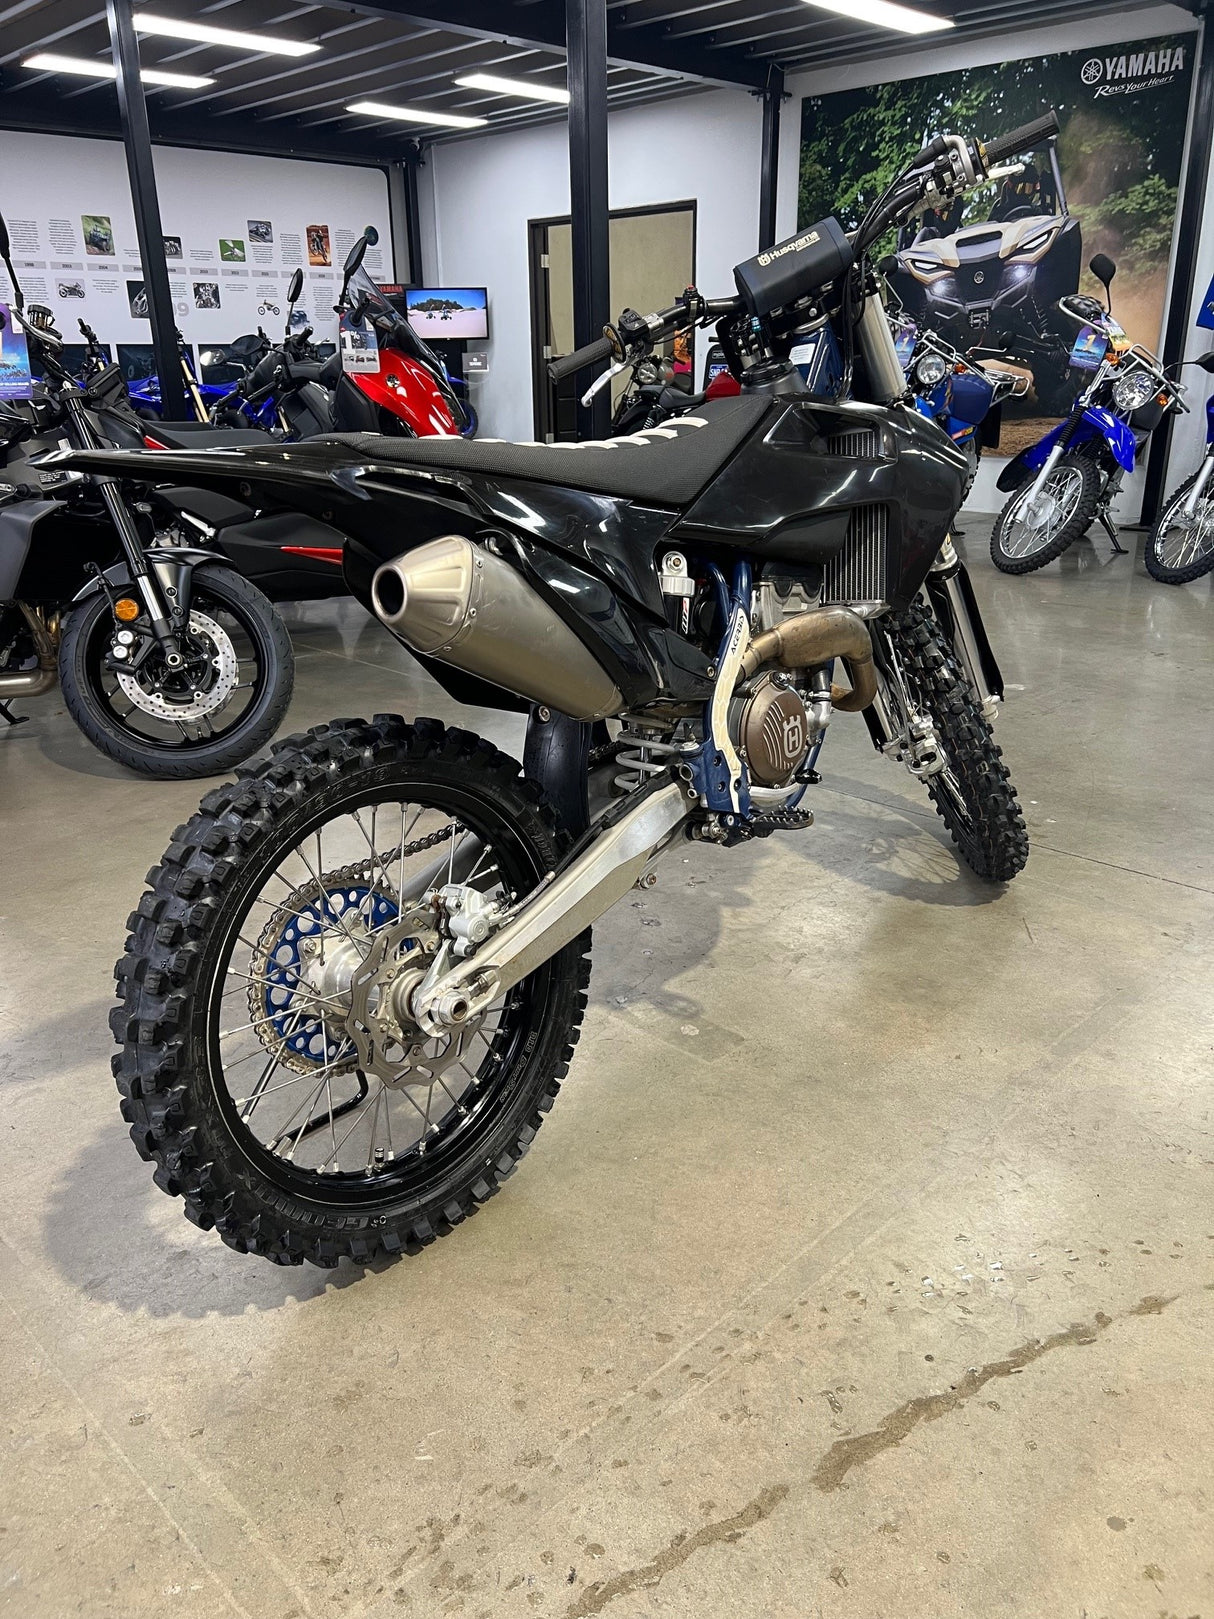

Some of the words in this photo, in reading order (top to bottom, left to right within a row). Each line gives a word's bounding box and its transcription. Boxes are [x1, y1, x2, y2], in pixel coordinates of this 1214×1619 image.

[1105, 47, 1184, 80] YAMAHA
[1093, 84, 1125, 99] Revs
[1124, 78, 1148, 94] Your
[1147, 74, 1175, 87] Heart
[769, 230, 820, 261] Husqvarna
[1083, 334, 1096, 351] 1
[731, 615, 745, 655] ACERBIS
